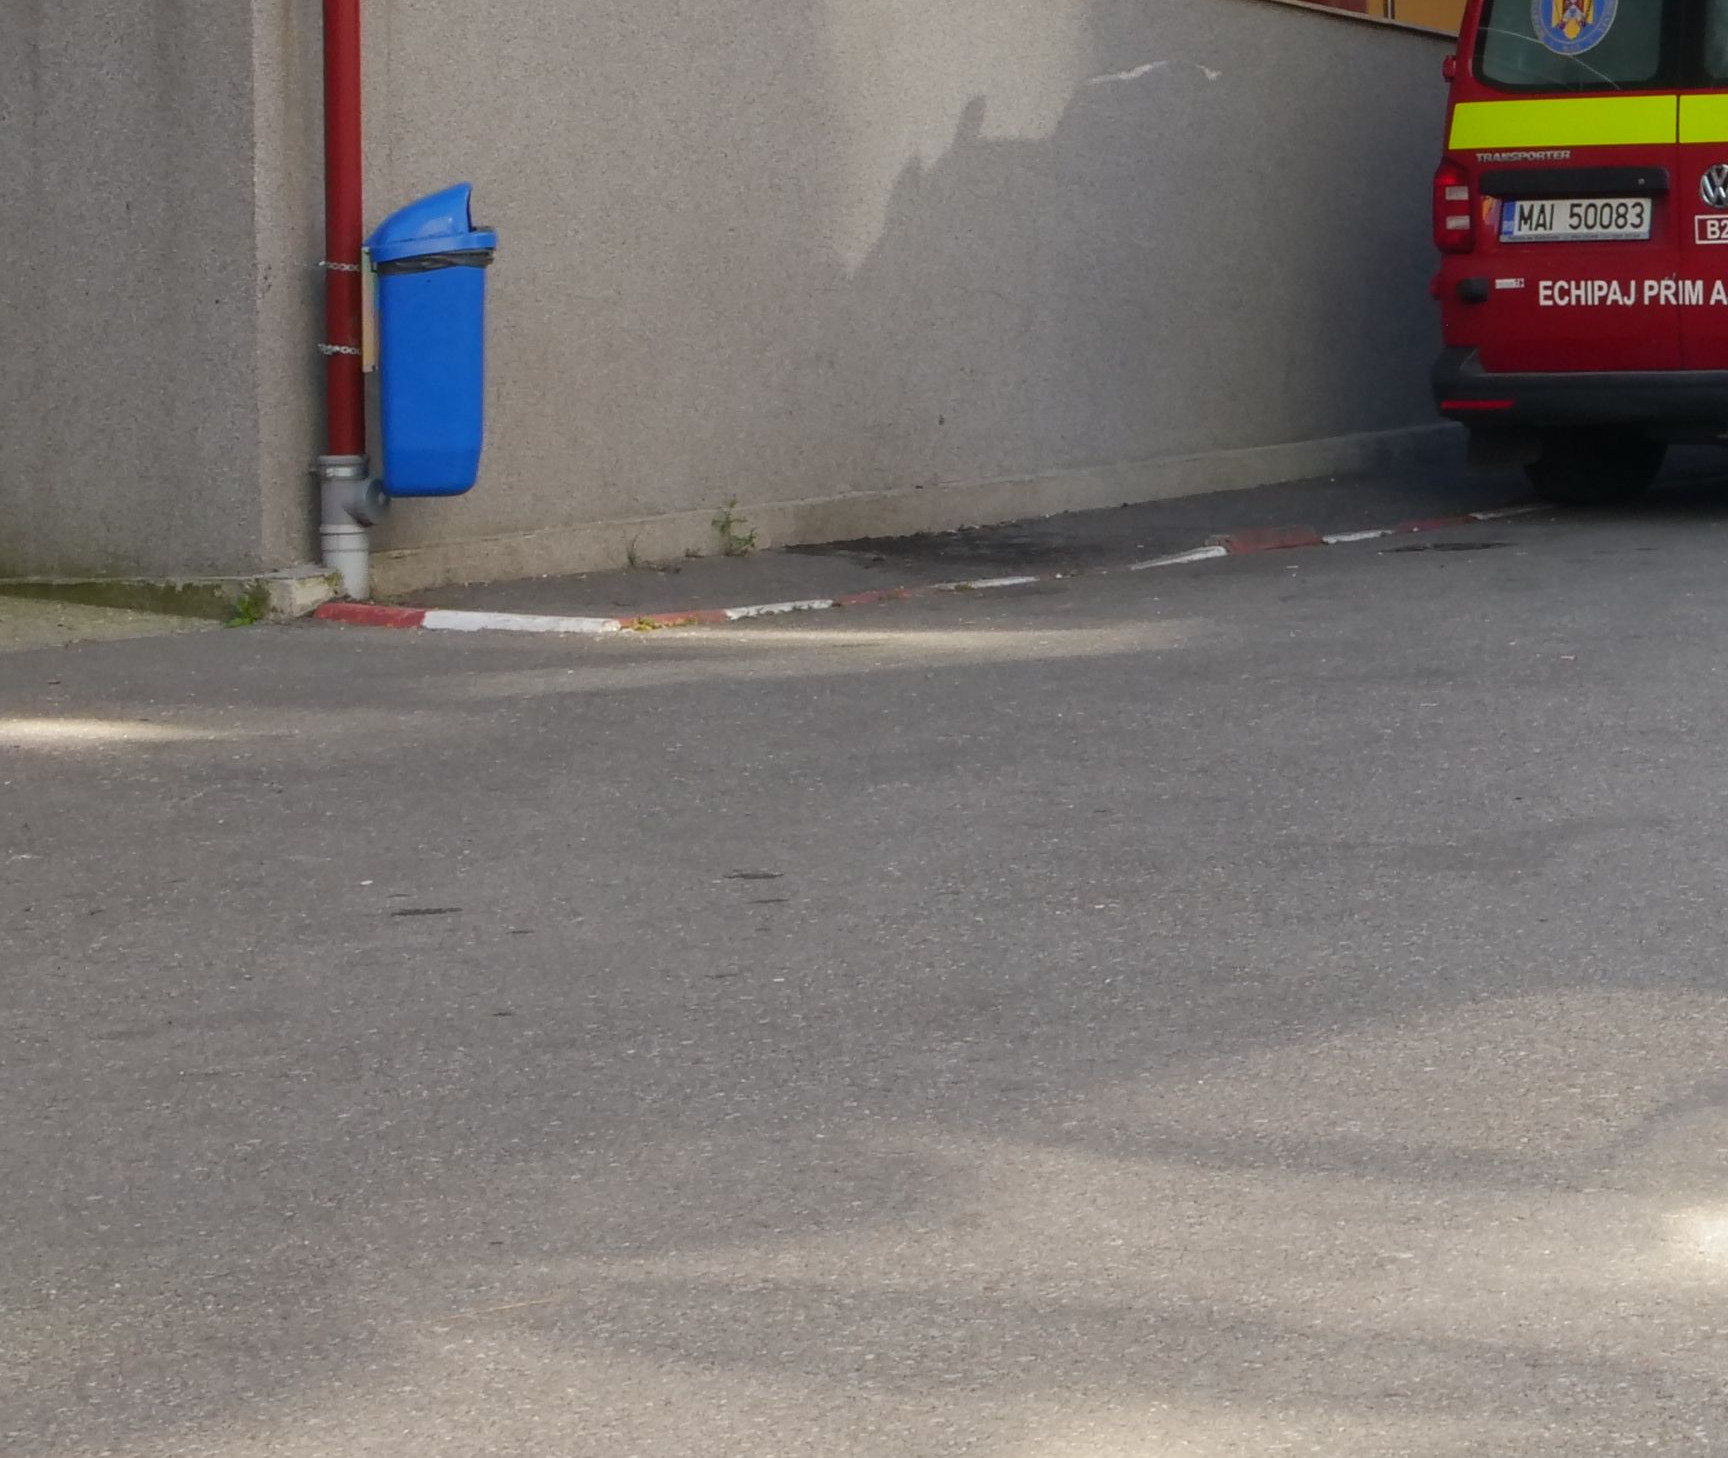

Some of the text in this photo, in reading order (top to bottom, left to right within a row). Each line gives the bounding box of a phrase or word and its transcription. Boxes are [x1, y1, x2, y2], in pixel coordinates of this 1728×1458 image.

[1476, 150, 1571, 162] TRANSPORTER
[1518, 202, 1645, 232] MAI 50083
[1539, 279, 1635, 307] ECHIPAJ
[1643, 279, 1704, 306] PRIM
